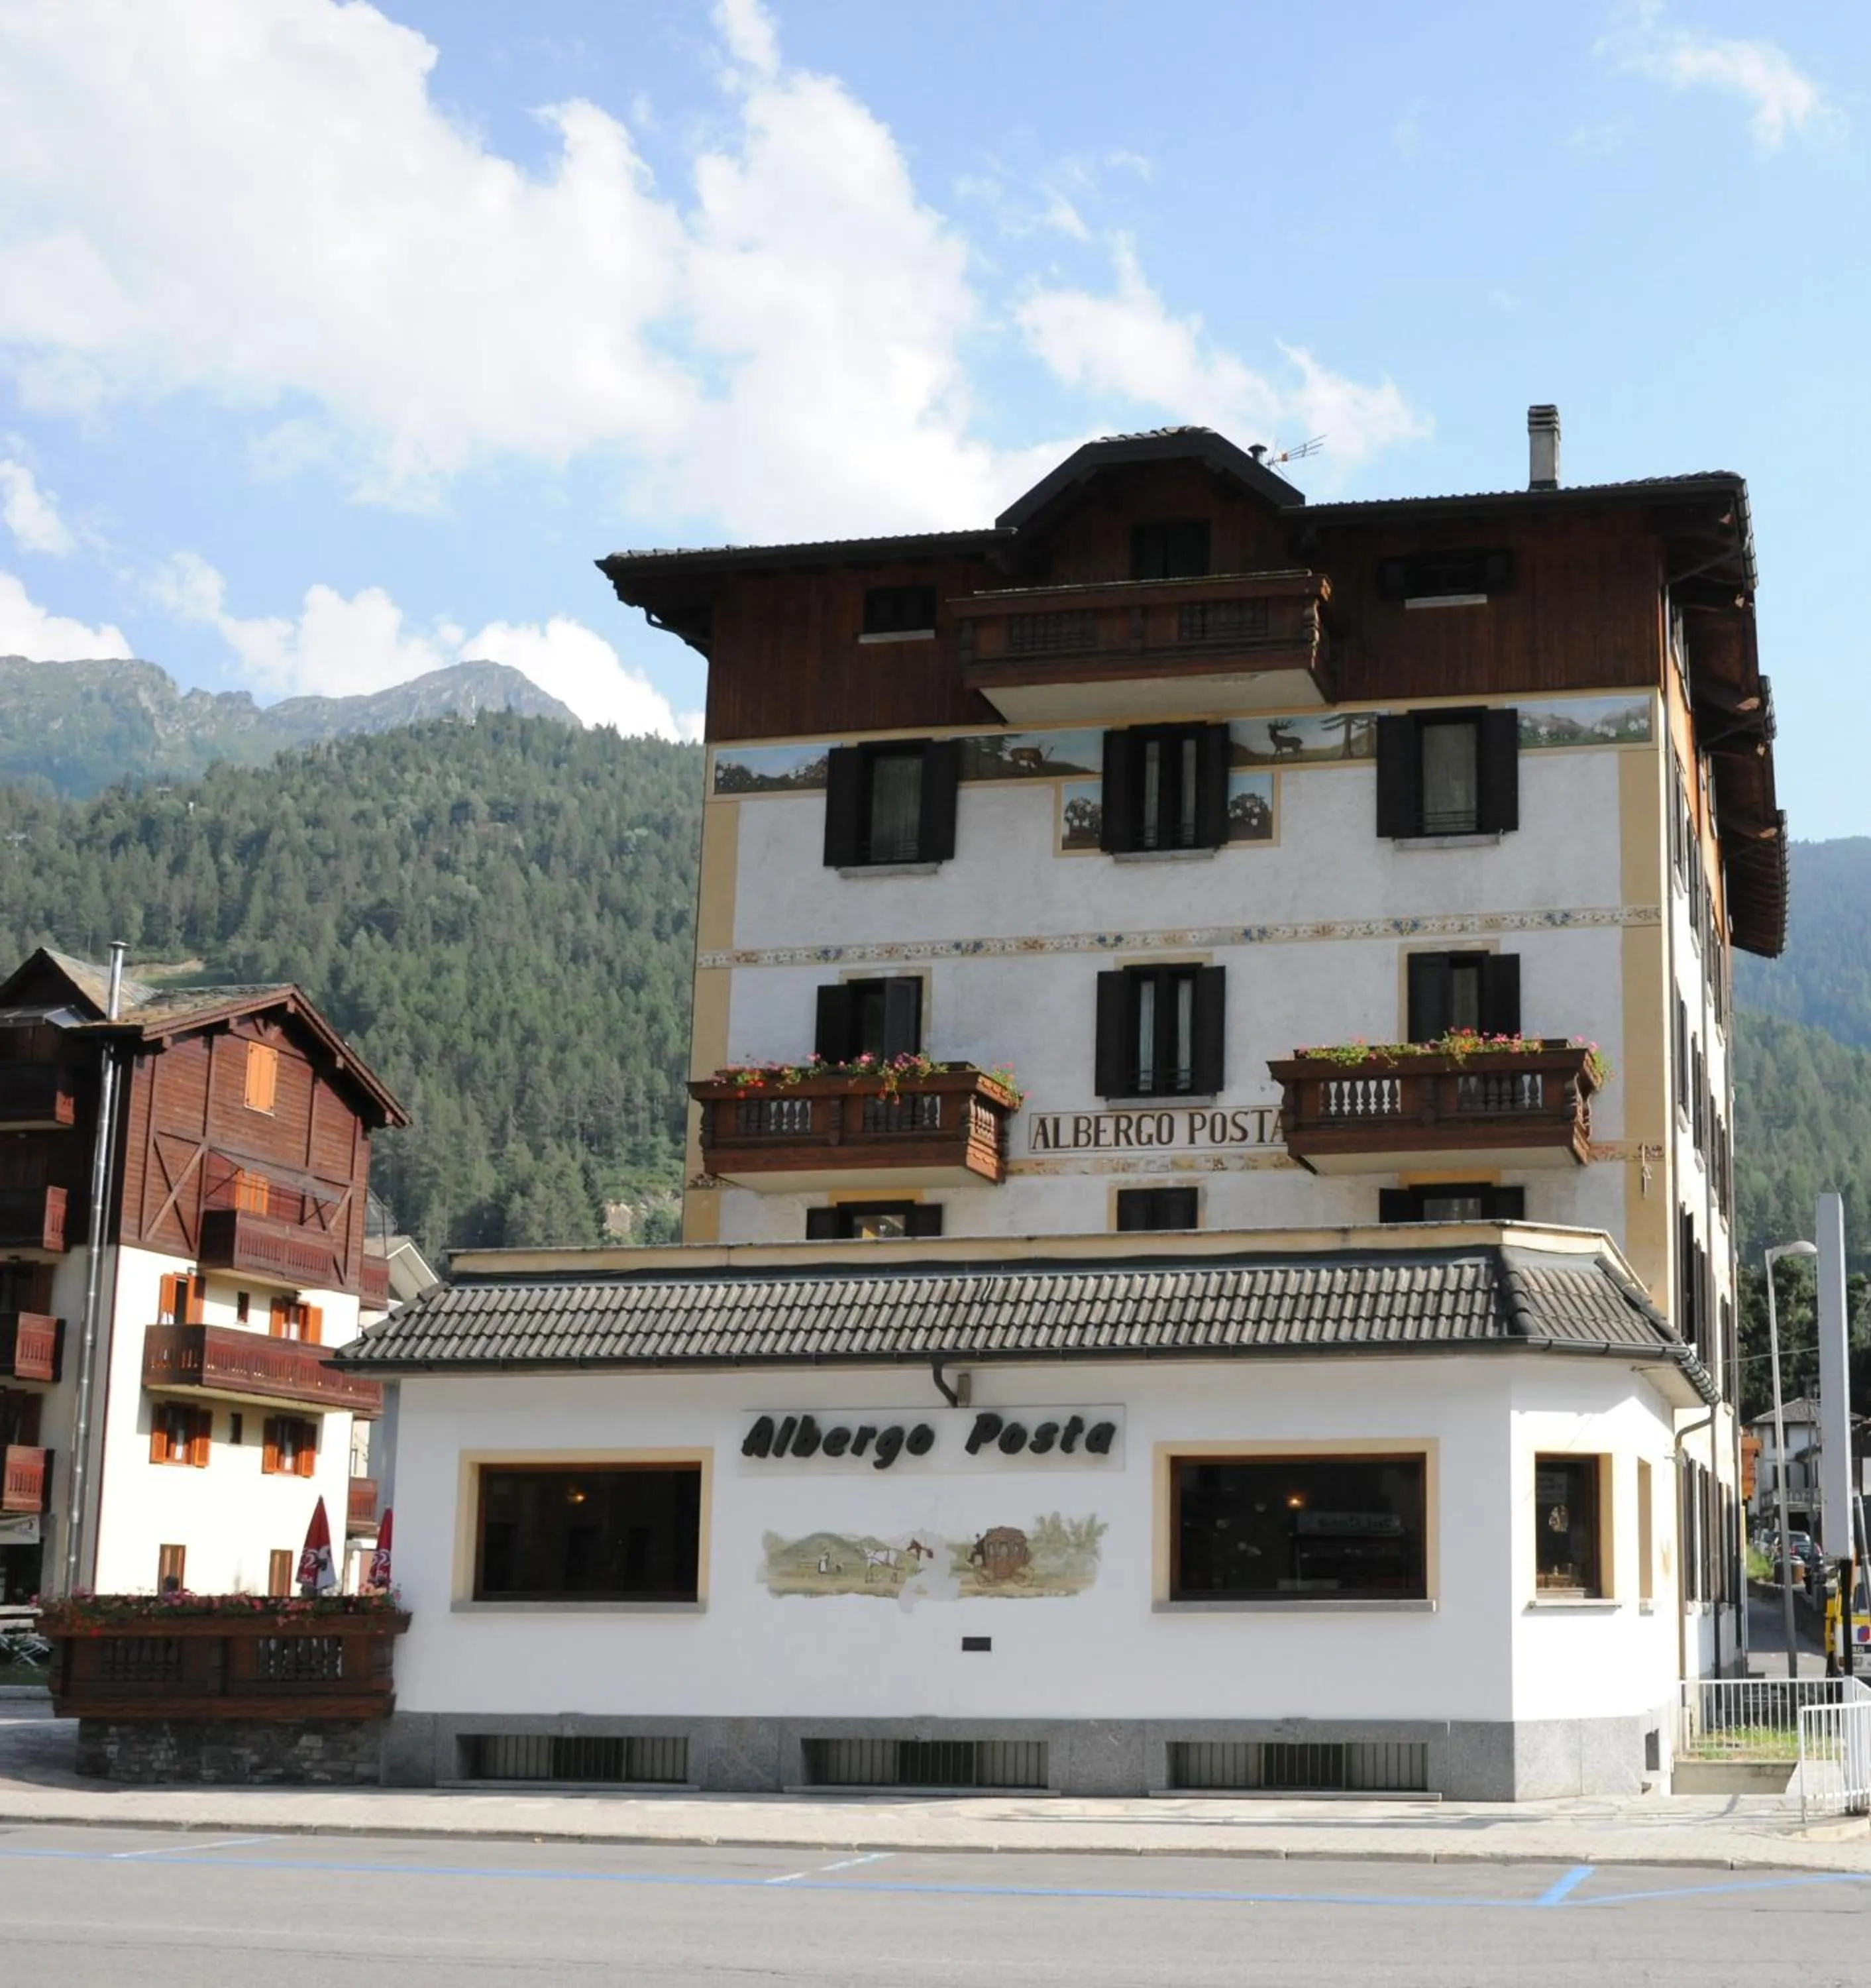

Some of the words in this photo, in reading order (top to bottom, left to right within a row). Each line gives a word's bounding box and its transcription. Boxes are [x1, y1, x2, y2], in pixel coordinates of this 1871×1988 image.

[1032, 1112, 1175, 1150] ALBERGO
[741, 1414, 935, 1470] Albergo
[965, 1411, 1116, 1455] Posta
